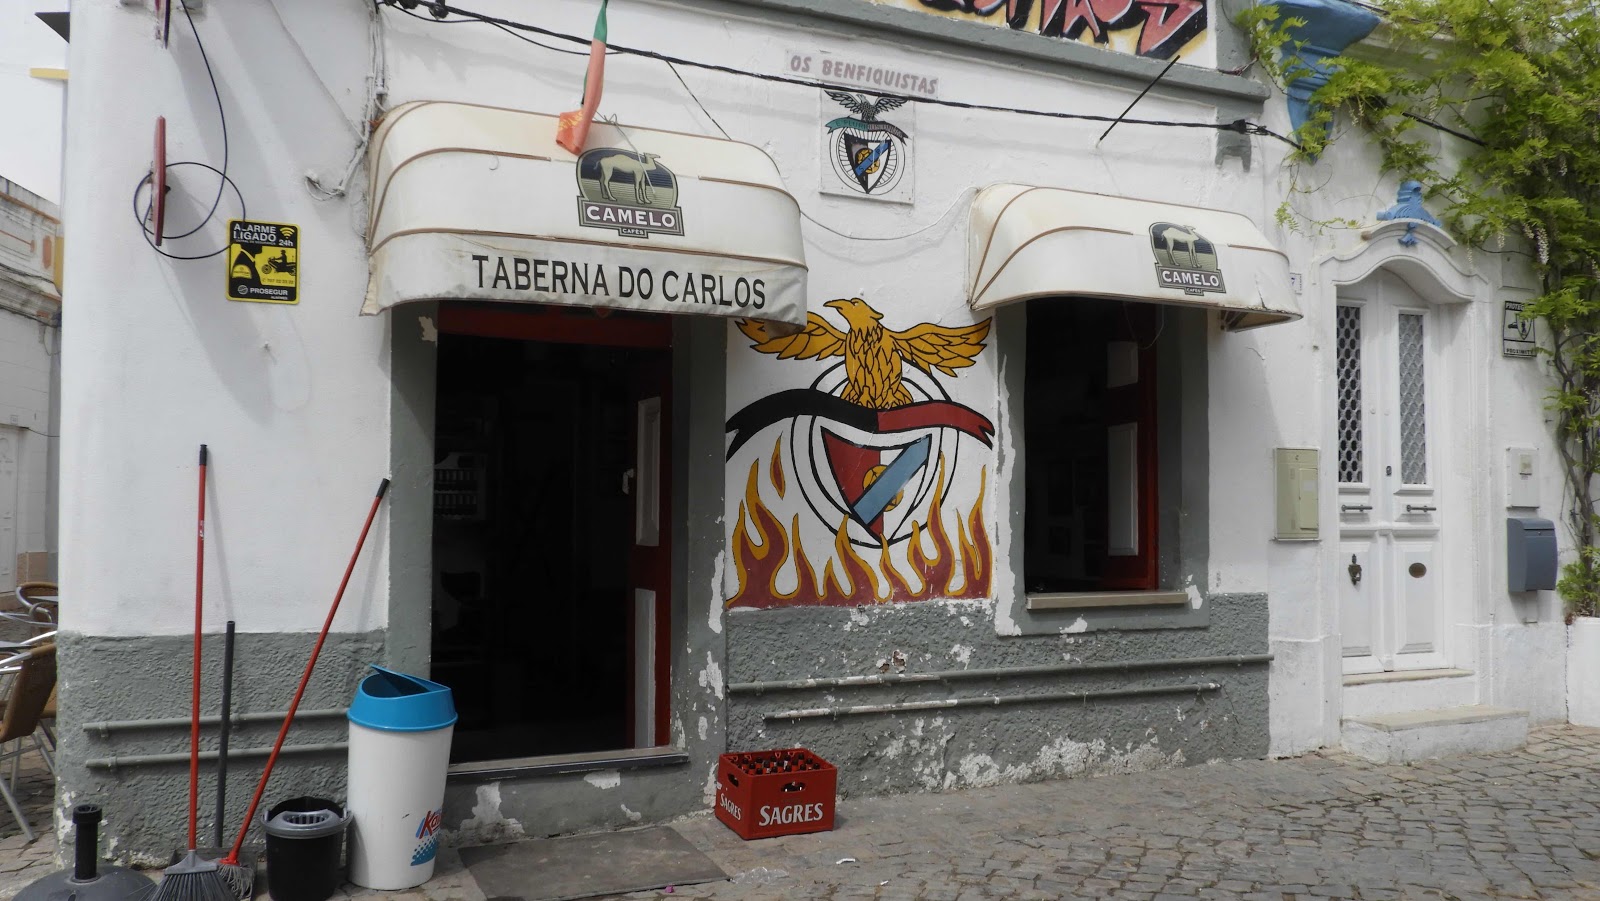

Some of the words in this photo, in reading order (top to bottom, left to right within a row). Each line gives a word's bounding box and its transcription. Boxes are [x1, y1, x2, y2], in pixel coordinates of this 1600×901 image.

[790, 54, 812, 73] OS
[822, 59, 938, 95] BENFIQUISTAS
[586, 205, 676, 229] CAMELO
[279, 239, 294, 247] 24h
[471, 254, 610, 297] TABERNA
[618, 266, 654, 300] DO
[661, 270, 766, 310] CARLOS
[1162, 270, 1220, 287] CAMELO
[249, 287, 288, 296] PROSEGUR
[719, 792, 742, 821] SAGRES
[758, 802, 824, 827] SAGRES
